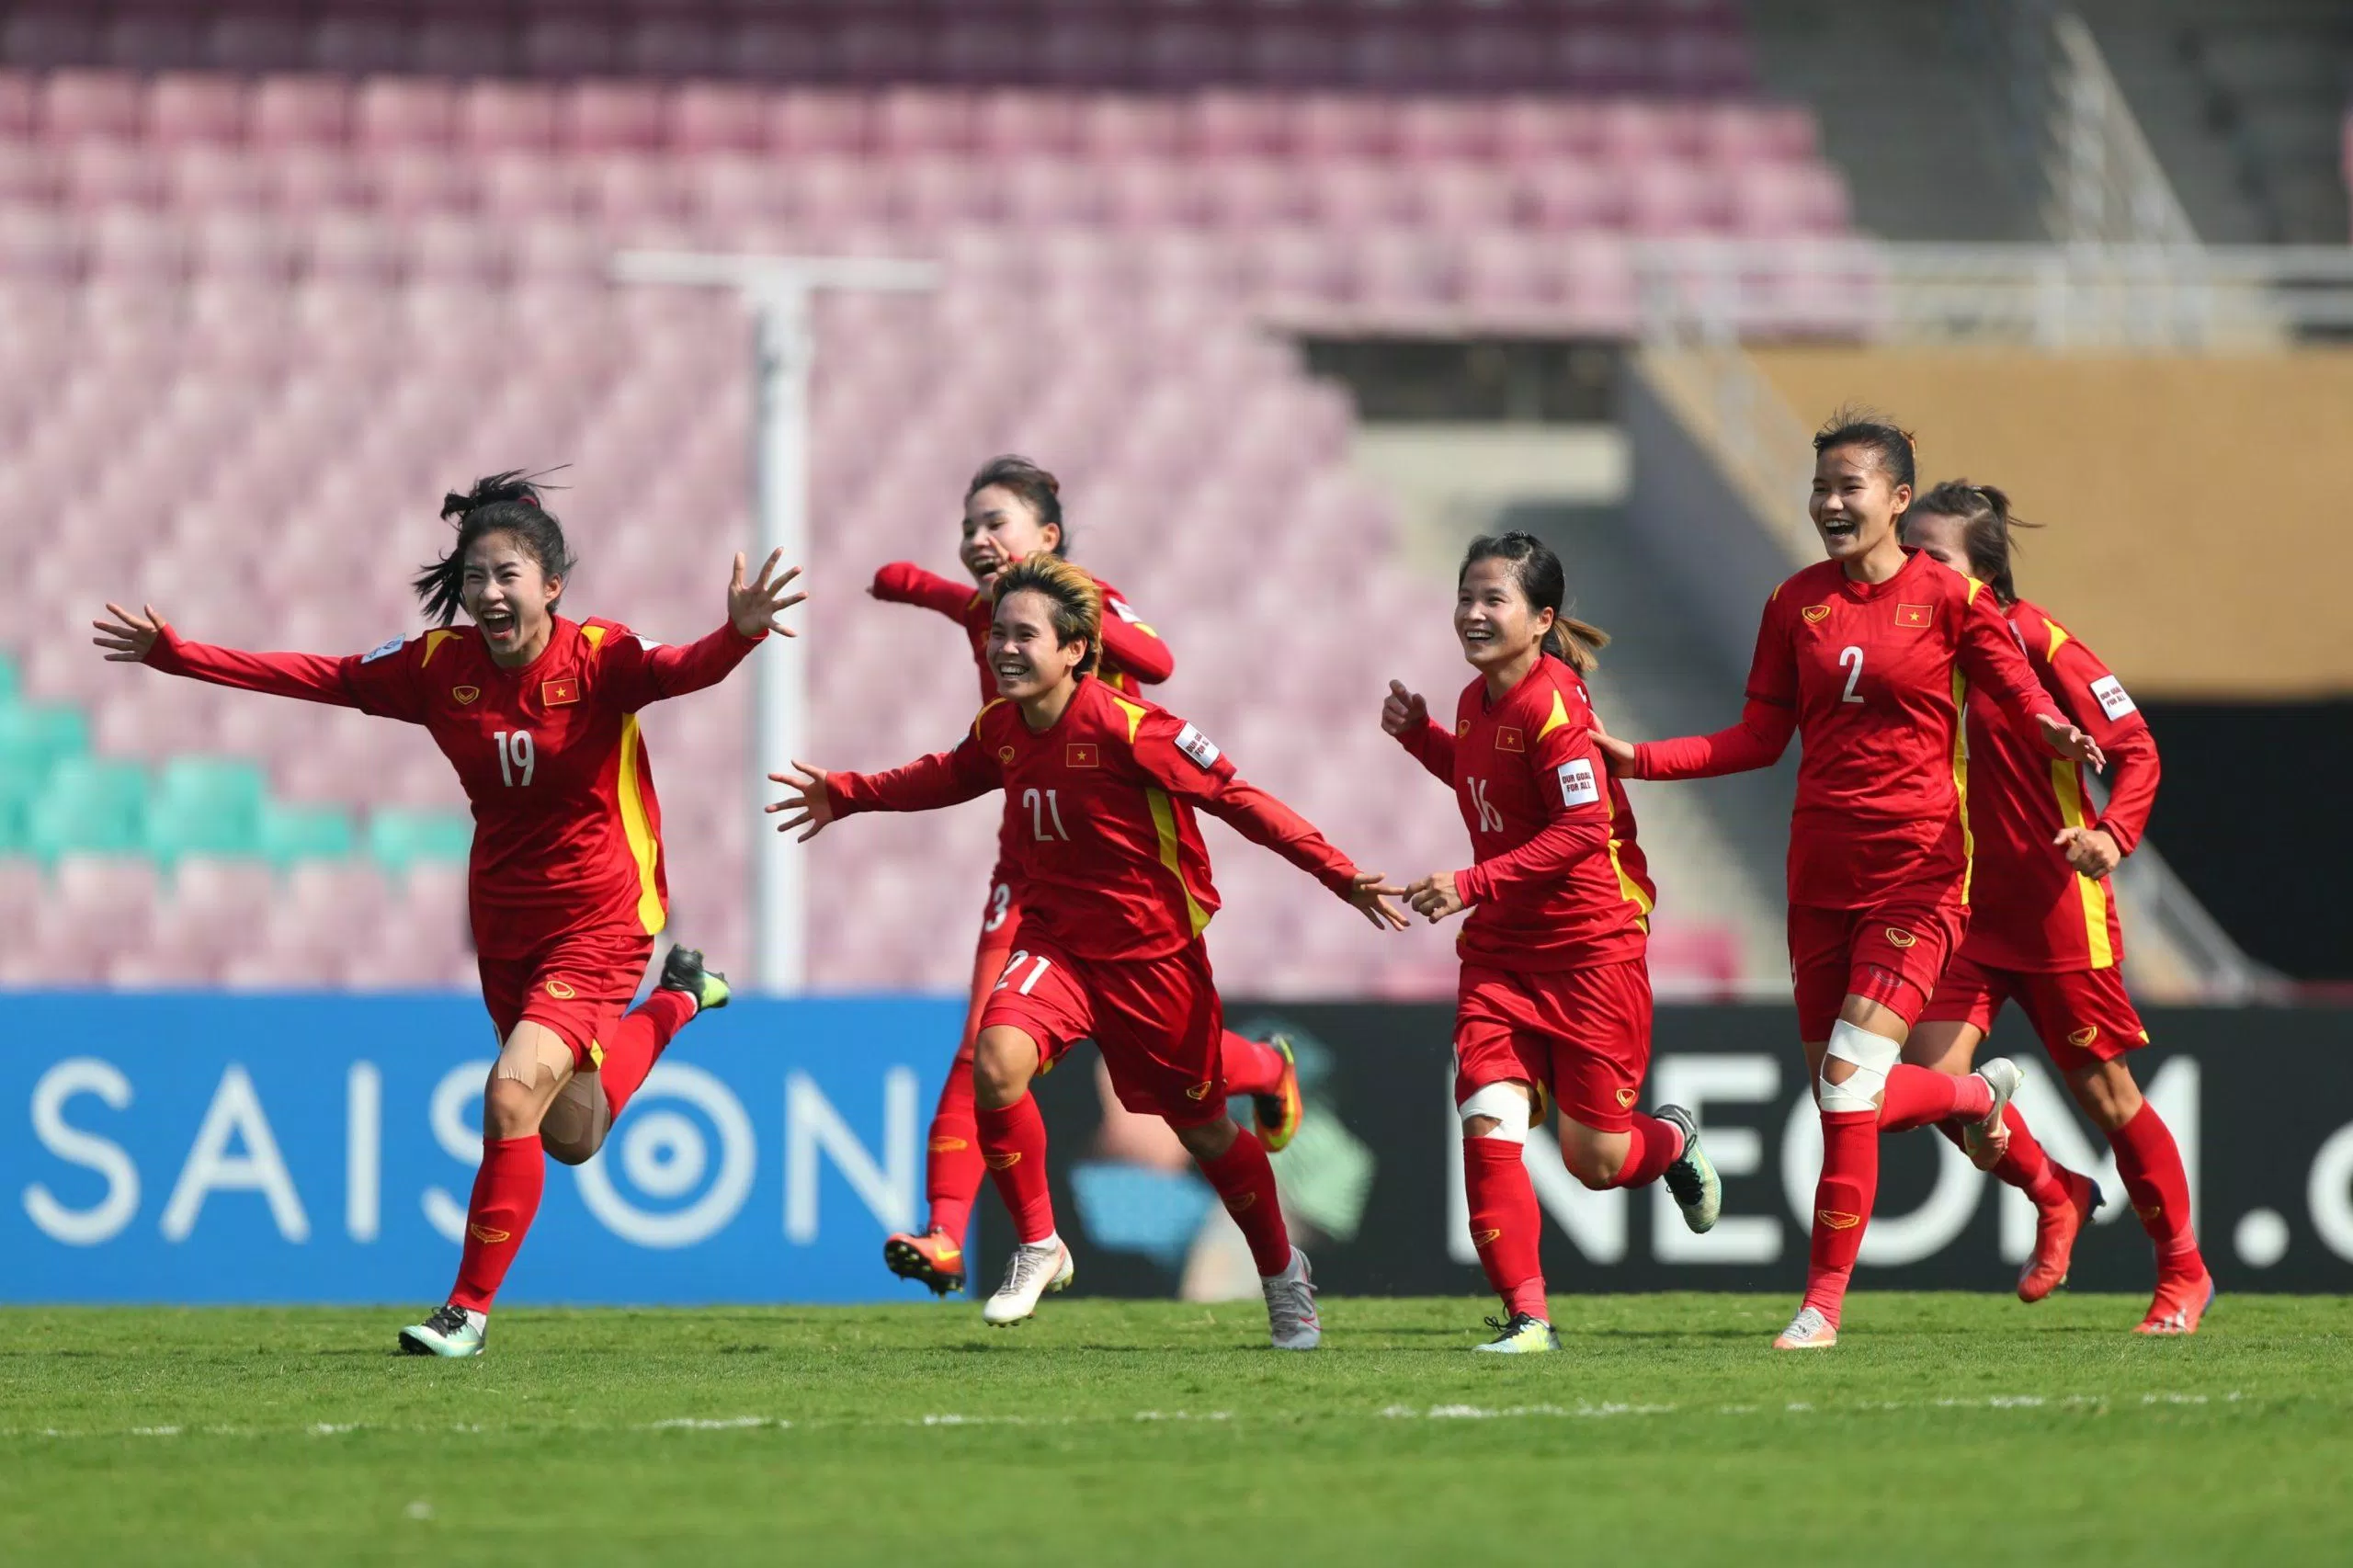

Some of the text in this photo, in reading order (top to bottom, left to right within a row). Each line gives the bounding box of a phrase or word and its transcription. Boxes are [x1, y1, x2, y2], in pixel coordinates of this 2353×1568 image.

[1837, 645, 1865, 703] 2
[494, 729, 535, 788] 19
[1562, 771, 1592, 785] OUR GOAL
[1467, 776, 1505, 834] 16
[1566, 780, 1591, 793] FOR ALL
[1022, 787, 1071, 843] 21
[985, 882, 1011, 933] 3
[993, 949, 1051, 996] 21
